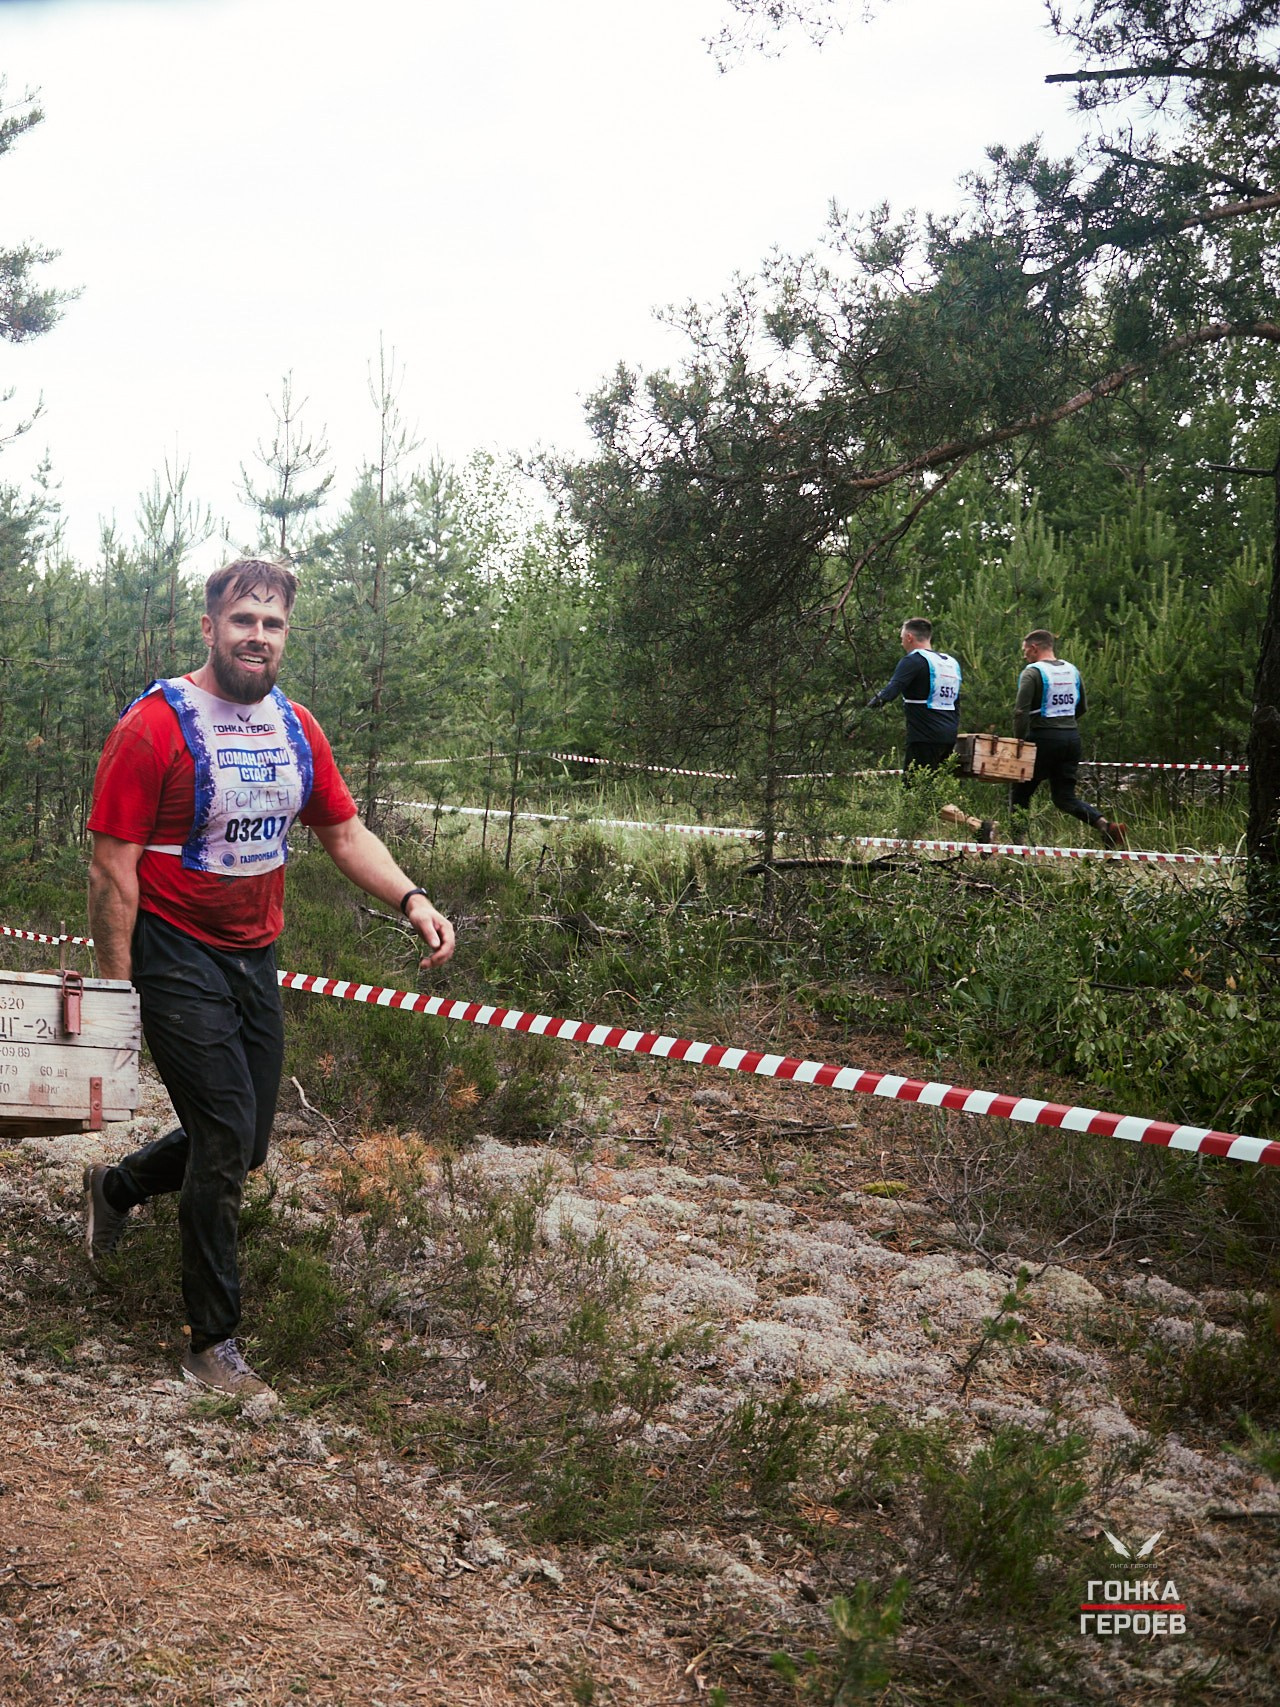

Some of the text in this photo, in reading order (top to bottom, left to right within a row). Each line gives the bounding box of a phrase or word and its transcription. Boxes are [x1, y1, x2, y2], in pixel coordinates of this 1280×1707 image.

[1052, 693, 1074, 705] 5505
[213, 725, 244, 733] ГОНКА
[218, 748, 289, 767] КОМАНДНЫЙ
[240, 766, 274, 782] СТАРТ
[225, 789, 290, 811] РОМАН
[240, 849, 279, 864] ГАЗПРОМБАНК
